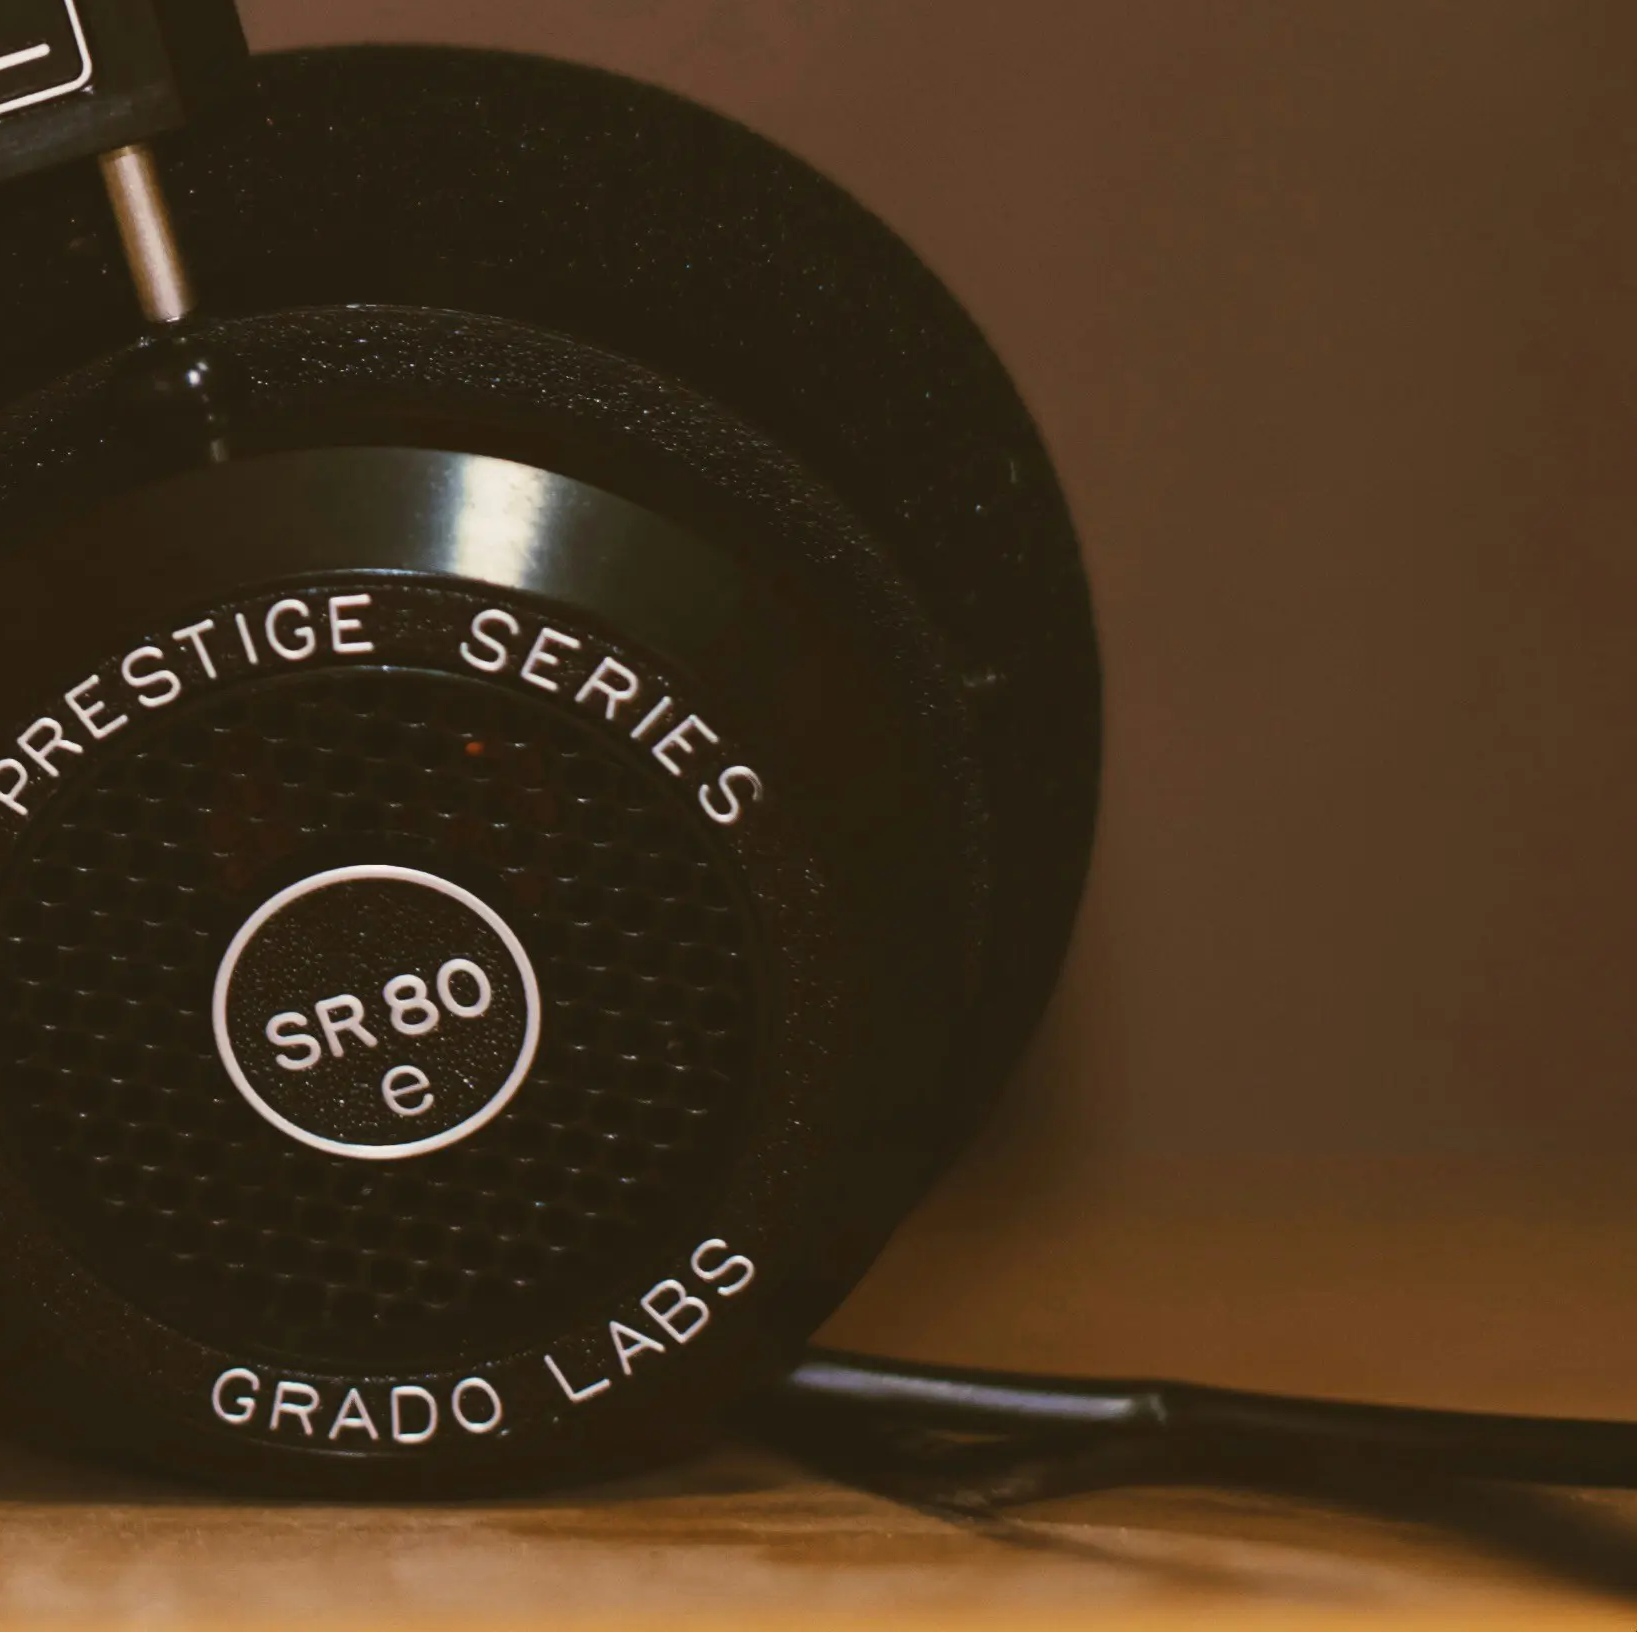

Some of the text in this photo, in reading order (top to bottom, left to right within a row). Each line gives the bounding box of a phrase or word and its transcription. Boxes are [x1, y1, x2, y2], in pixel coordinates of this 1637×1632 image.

[459, 607, 762, 823] SERIES
[381, 1063, 435, 1117] e
[210, 1237, 756, 1445] GRADO LABS
